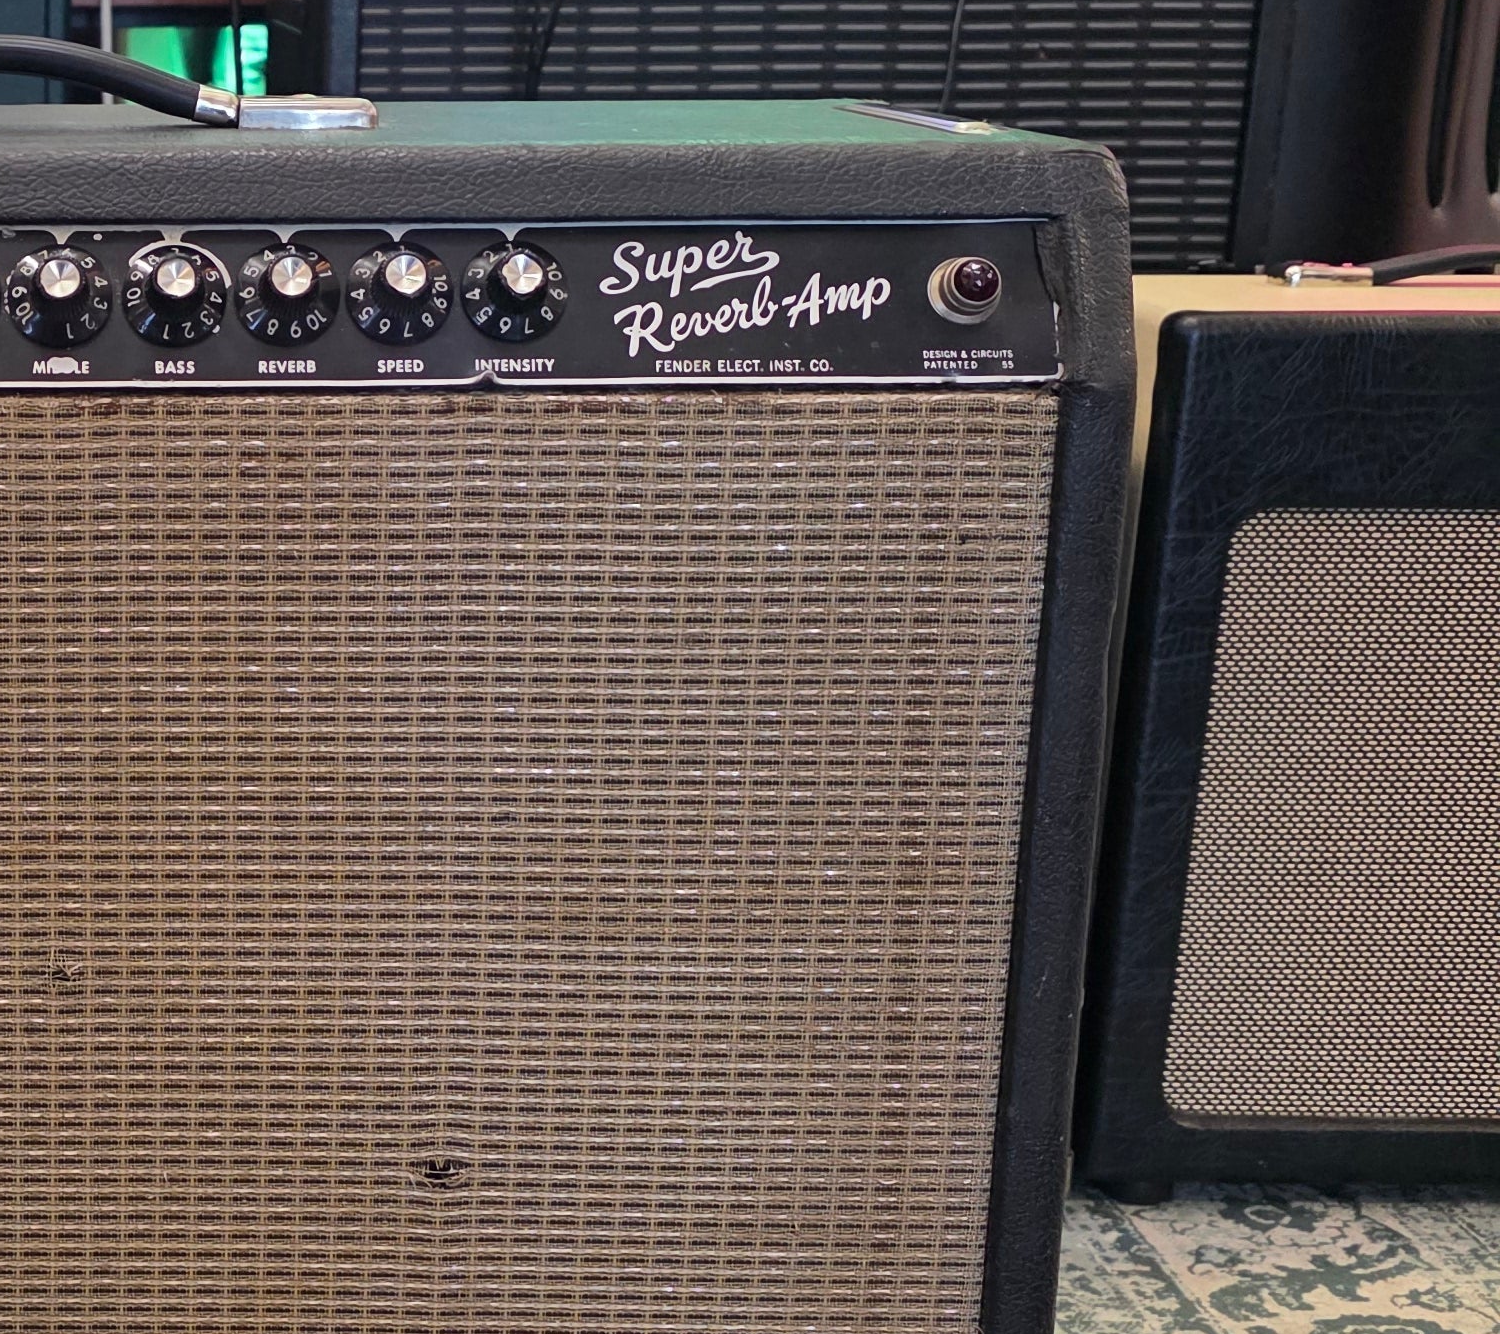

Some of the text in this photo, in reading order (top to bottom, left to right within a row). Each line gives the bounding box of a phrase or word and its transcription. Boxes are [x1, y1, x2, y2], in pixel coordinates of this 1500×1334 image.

[147, 255, 160, 265] 8
[263, 249, 275, 261] 4
[372, 250, 387, 263] 2
[483, 250, 499, 263] 2
[80, 256, 97, 269] 5
[599, 230, 780, 298] Super
[20, 265, 33, 277] 8
[205, 270, 220, 282] 5
[243, 266, 260, 278] 5
[318, 269, 333, 278] 1
[355, 268, 371, 279] 3
[467, 268, 485, 279] 3
[546, 261, 562, 281] 10
[93, 275, 108, 288] 4
[433, 275, 448, 292] 10
[126, 287, 141, 307] 10
[209, 291, 223, 305] 4
[350, 288, 366, 301] 4
[465, 288, 481, 300] 4
[94, 297, 108, 310] 3
[15, 302, 34, 325] 10
[199, 310, 214, 326] 3
[246, 307, 262, 323] 7
[305, 309, 327, 331] 10
[358, 306, 374, 321] 5
[422, 312, 435, 328] 8
[476, 306, 493, 324] 5
[540, 306, 554, 322] 8
[613, 272, 891, 357] Reverb-Amp
[80, 313, 95, 330] 2
[266, 318, 279, 336] 8
[524, 318, 534, 334] 7
[65, 323, 74, 340] 1
[162, 324, 169, 339] 1
[181, 321, 195, 339] 2
[403, 322, 414, 338] 7
[922, 349, 1014, 359] DESIGN & CIRCUITS
[154, 360, 195, 374] BASS
[258, 360, 317, 374] REVERB
[377, 359, 425, 373] SPEED
[475, 358, 555, 372] INTENSITY
[655, 359, 834, 372] FENDER ELECT. INST. CO.
[923, 360, 978, 370] PATENTED
